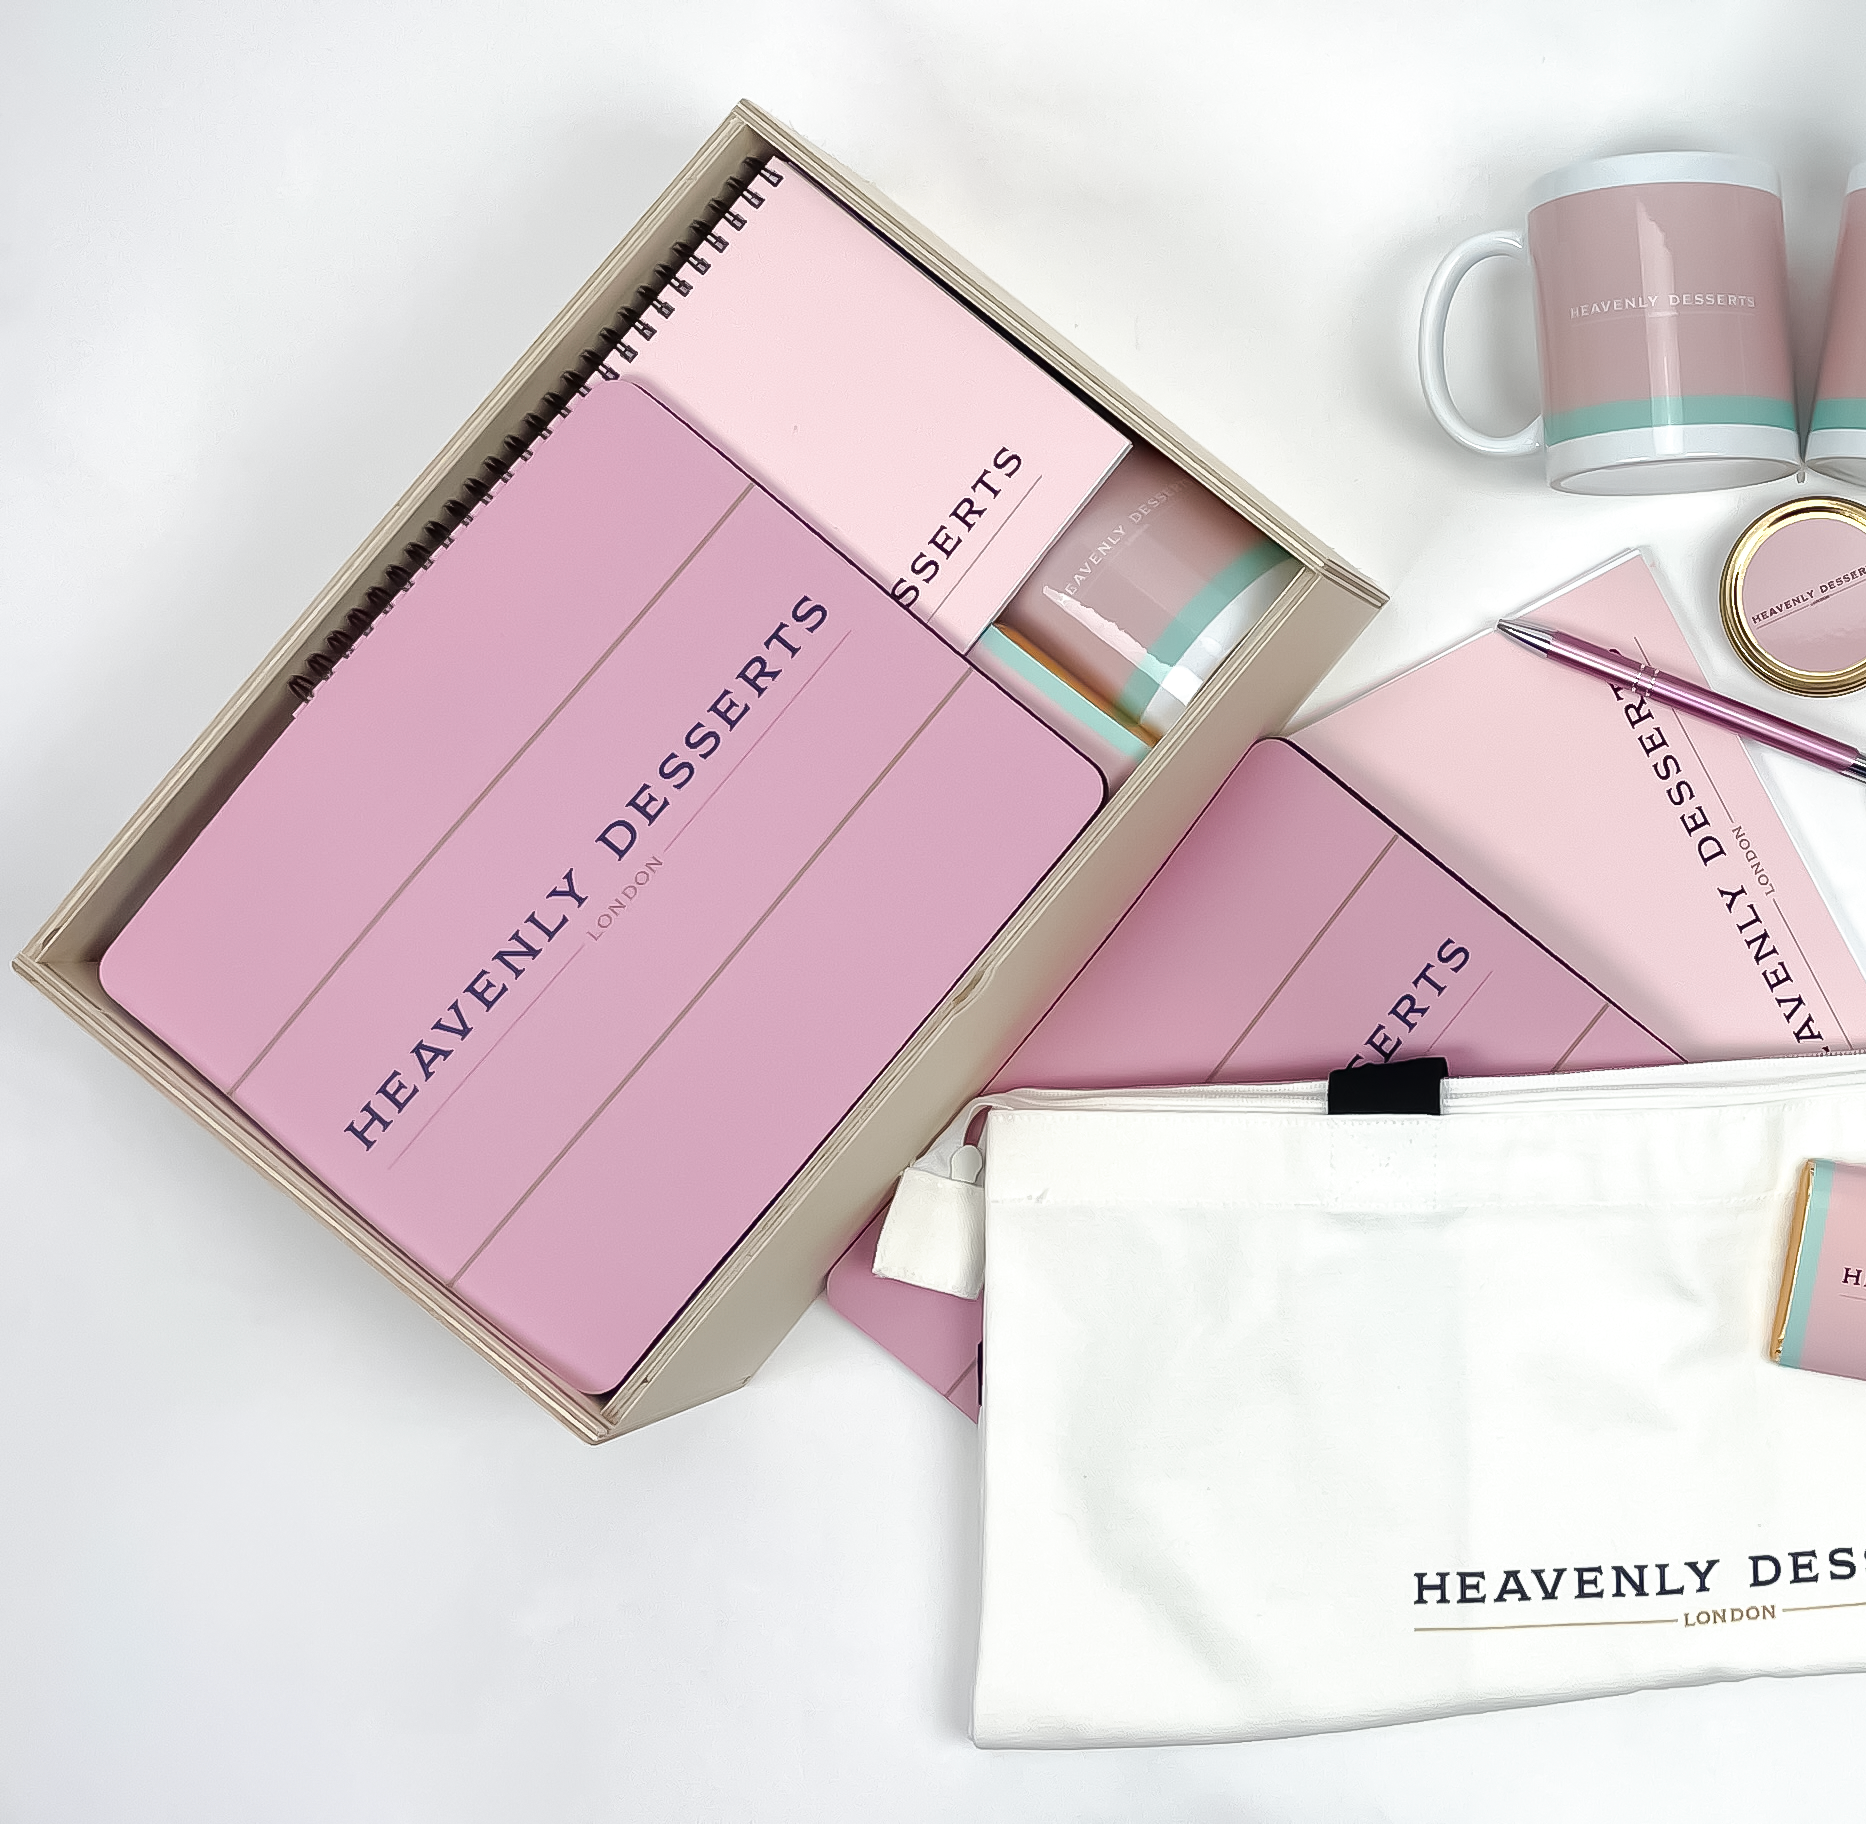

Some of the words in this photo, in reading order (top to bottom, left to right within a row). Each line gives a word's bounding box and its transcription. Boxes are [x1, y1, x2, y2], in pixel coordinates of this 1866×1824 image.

[1570, 295, 1658, 320] HEAVENLY
[1668, 293, 1756, 308] DESSERTS
[1752, 589, 1814, 624] HEAVENLY
[1608, 649, 1727, 867] DESSER
[343, 866, 589, 1153] HEAVENLY
[594, 594, 829, 861] DESSERTS
[1731, 825, 1776, 897] LONDON
[586, 855, 664, 942] LONDON
[1717, 884, 1829, 1053] AVENLY
[1414, 1558, 1720, 1605] HEAVENLY
[1683, 1604, 1777, 1628] LONDON
